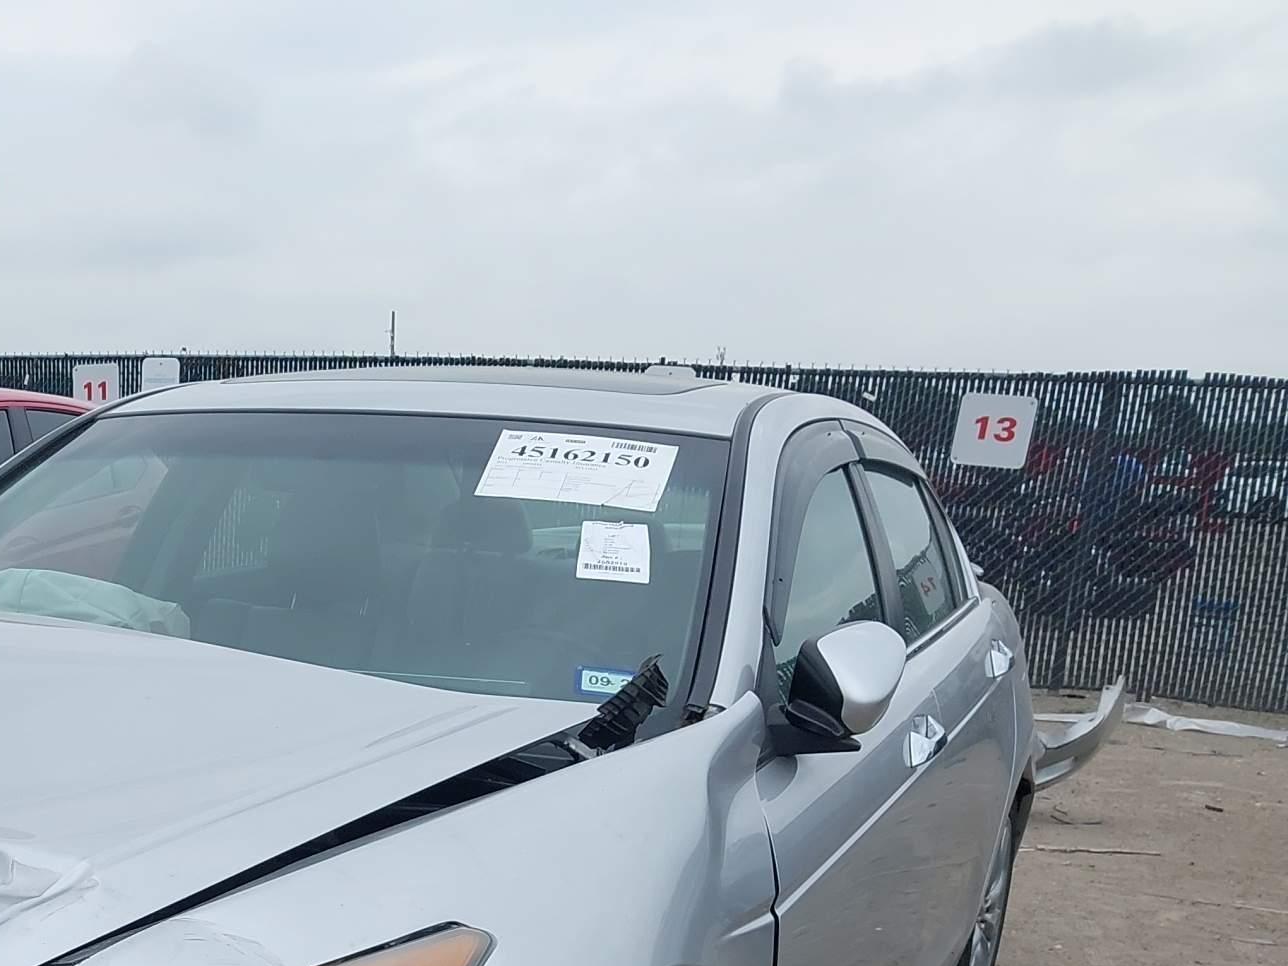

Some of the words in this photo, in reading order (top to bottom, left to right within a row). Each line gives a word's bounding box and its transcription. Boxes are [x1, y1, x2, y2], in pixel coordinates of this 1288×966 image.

[83, 381, 108, 401] 11
[974, 415, 1018, 443] 13
[511, 444, 651, 469] 45162150
